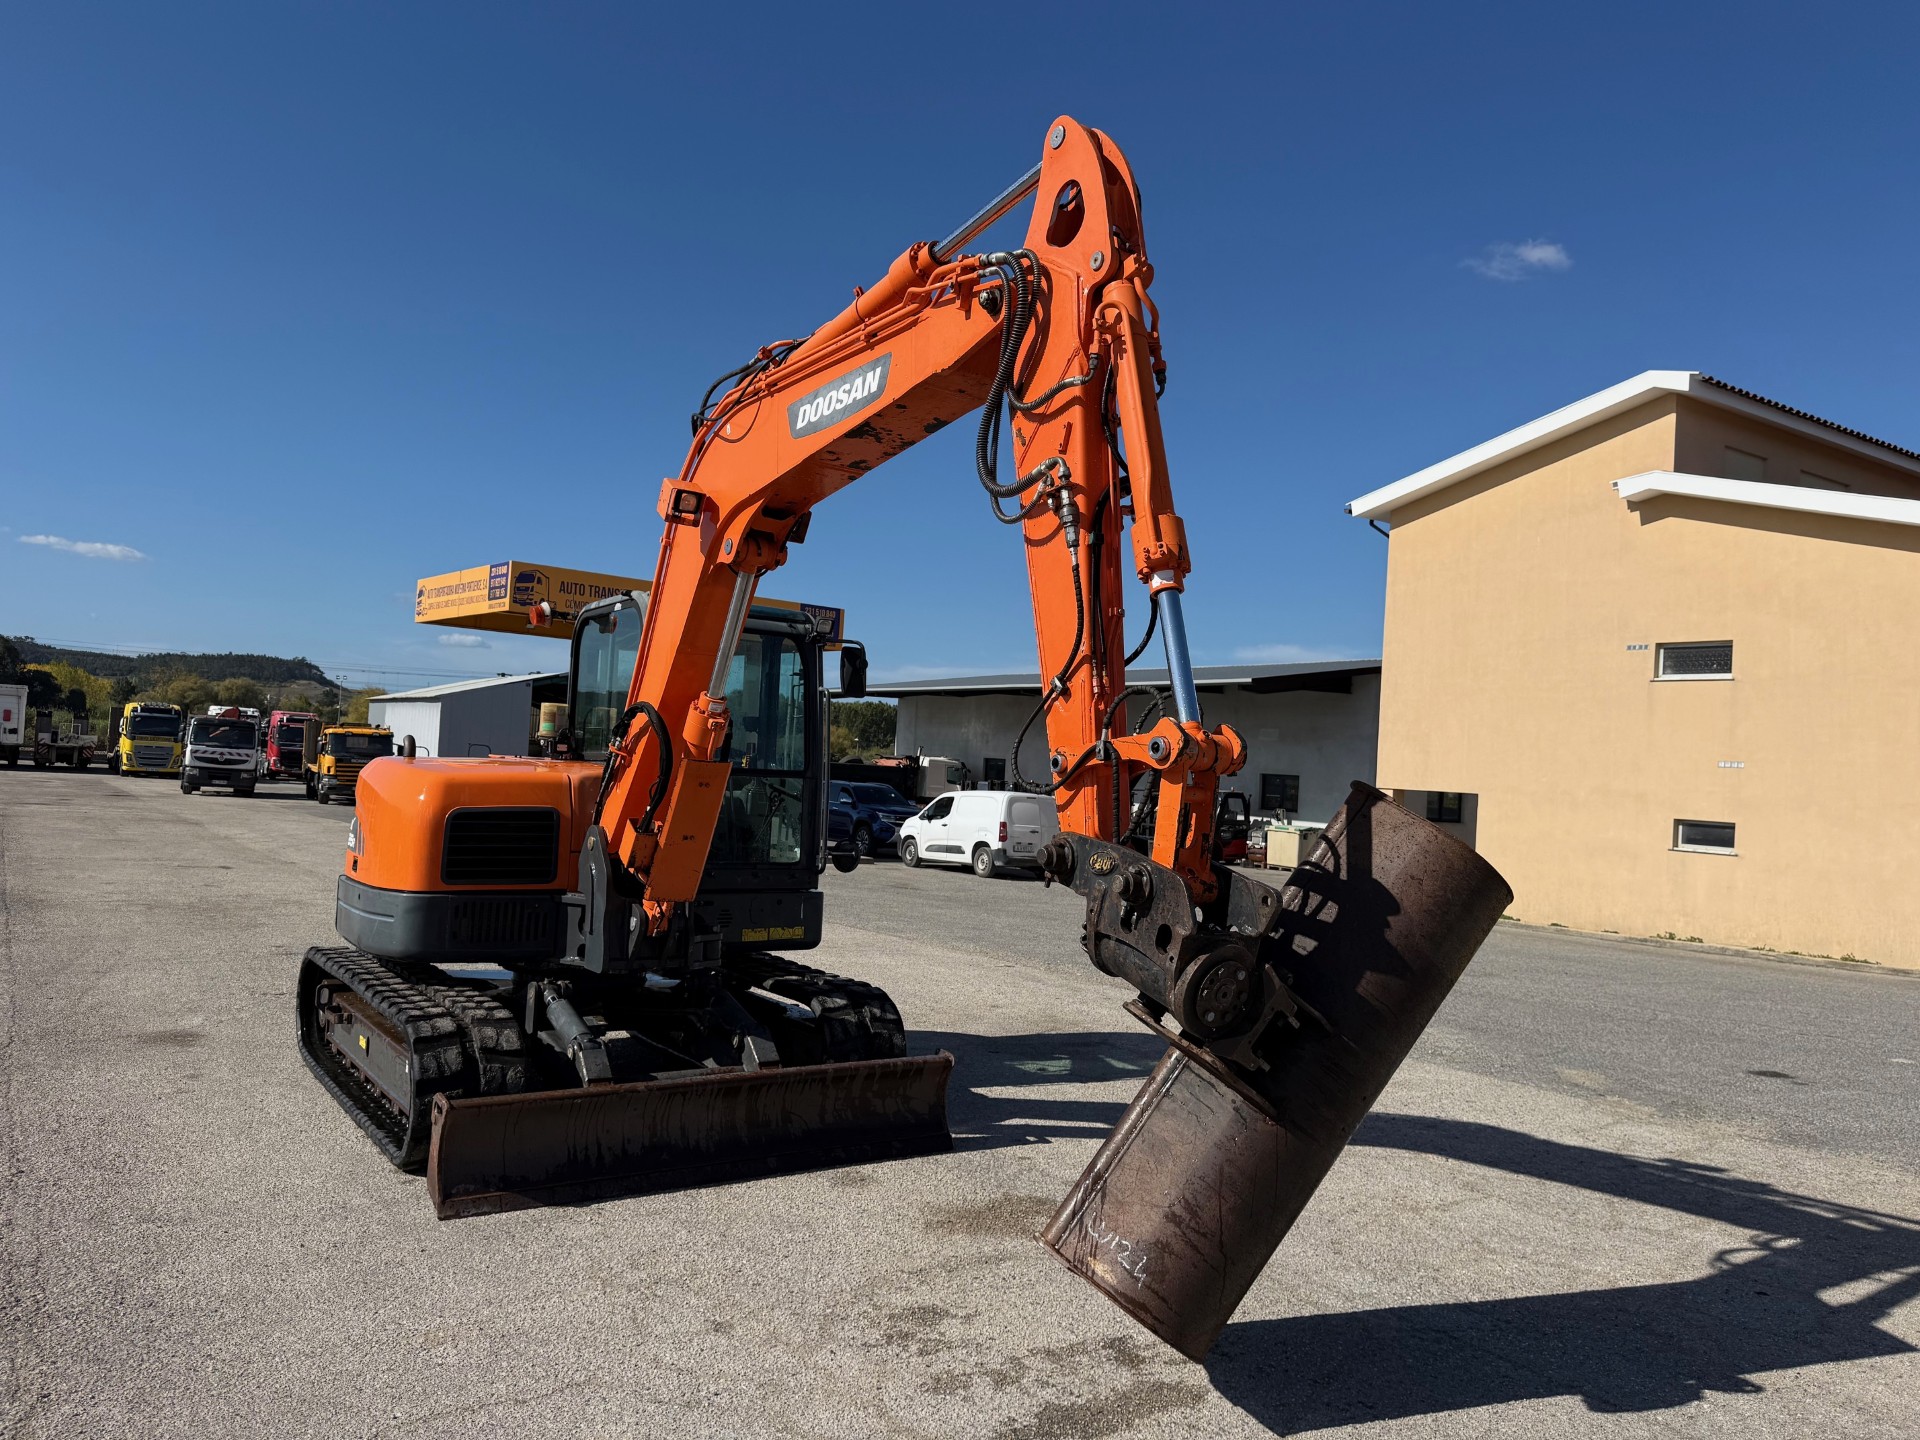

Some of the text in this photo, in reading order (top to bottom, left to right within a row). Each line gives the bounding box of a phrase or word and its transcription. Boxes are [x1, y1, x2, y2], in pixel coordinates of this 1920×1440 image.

[796, 366, 882, 430] DOOSAN
[559, 581, 624, 598] AUTO TRANS
